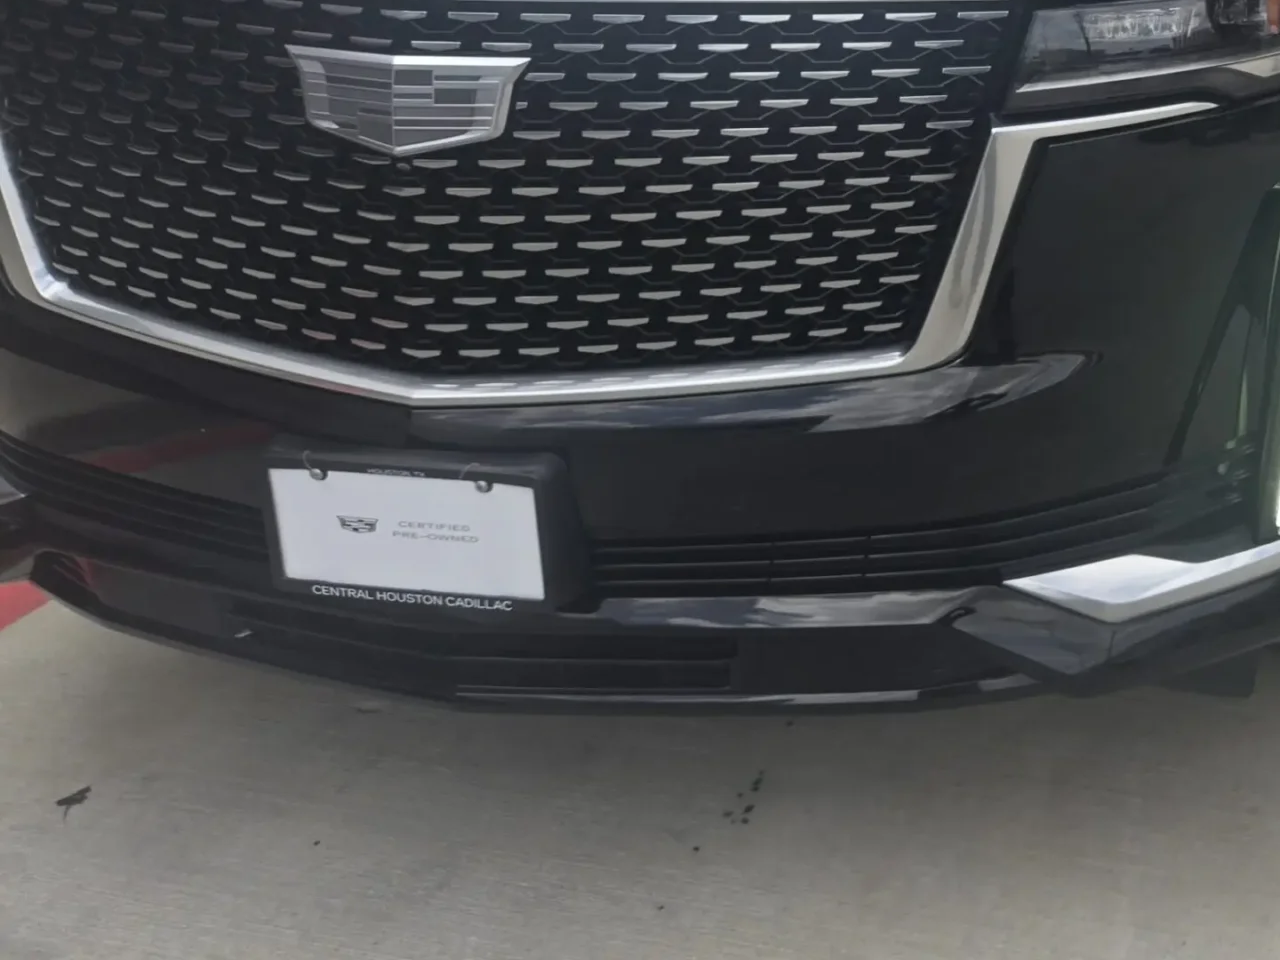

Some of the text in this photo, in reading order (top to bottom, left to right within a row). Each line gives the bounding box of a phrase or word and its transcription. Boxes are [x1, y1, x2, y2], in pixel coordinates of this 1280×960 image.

[398, 520, 470, 532] CERTIFIED
[392, 530, 479, 543] PRE-OWNED
[312, 584, 513, 611] CENTRAL HOUSTON CADILLAC
